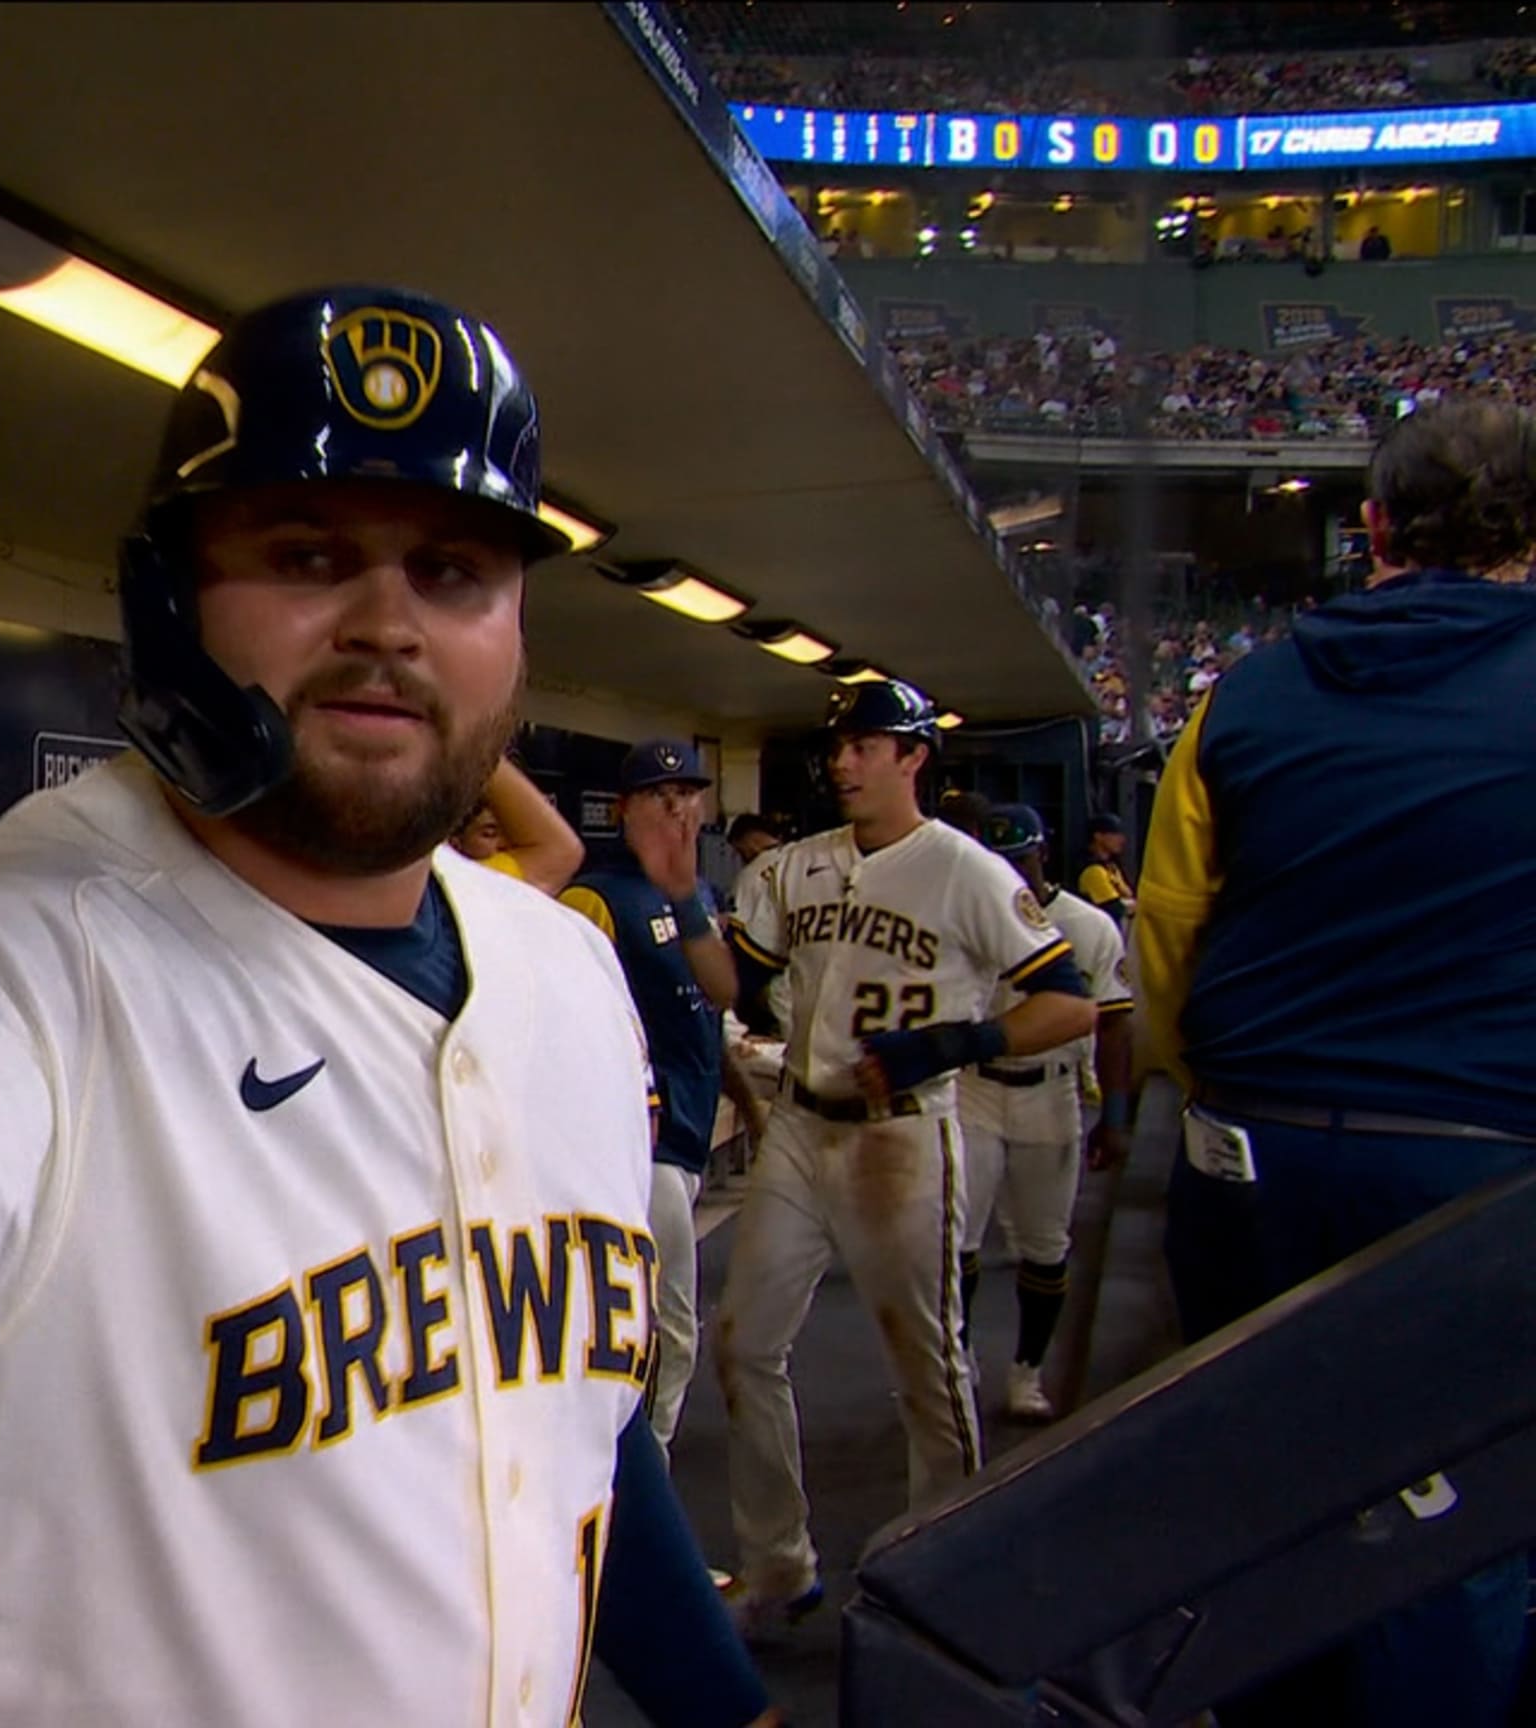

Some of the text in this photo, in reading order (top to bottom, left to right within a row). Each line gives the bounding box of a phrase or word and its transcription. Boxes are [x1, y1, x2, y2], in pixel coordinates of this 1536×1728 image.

[947, 119, 976, 161] B
[1047, 121, 1075, 163] S
[1249, 119, 1500, 155] 17 CHRIS ARCHER
[785, 902, 939, 970] BREWERS
[852, 981, 935, 1038] 22
